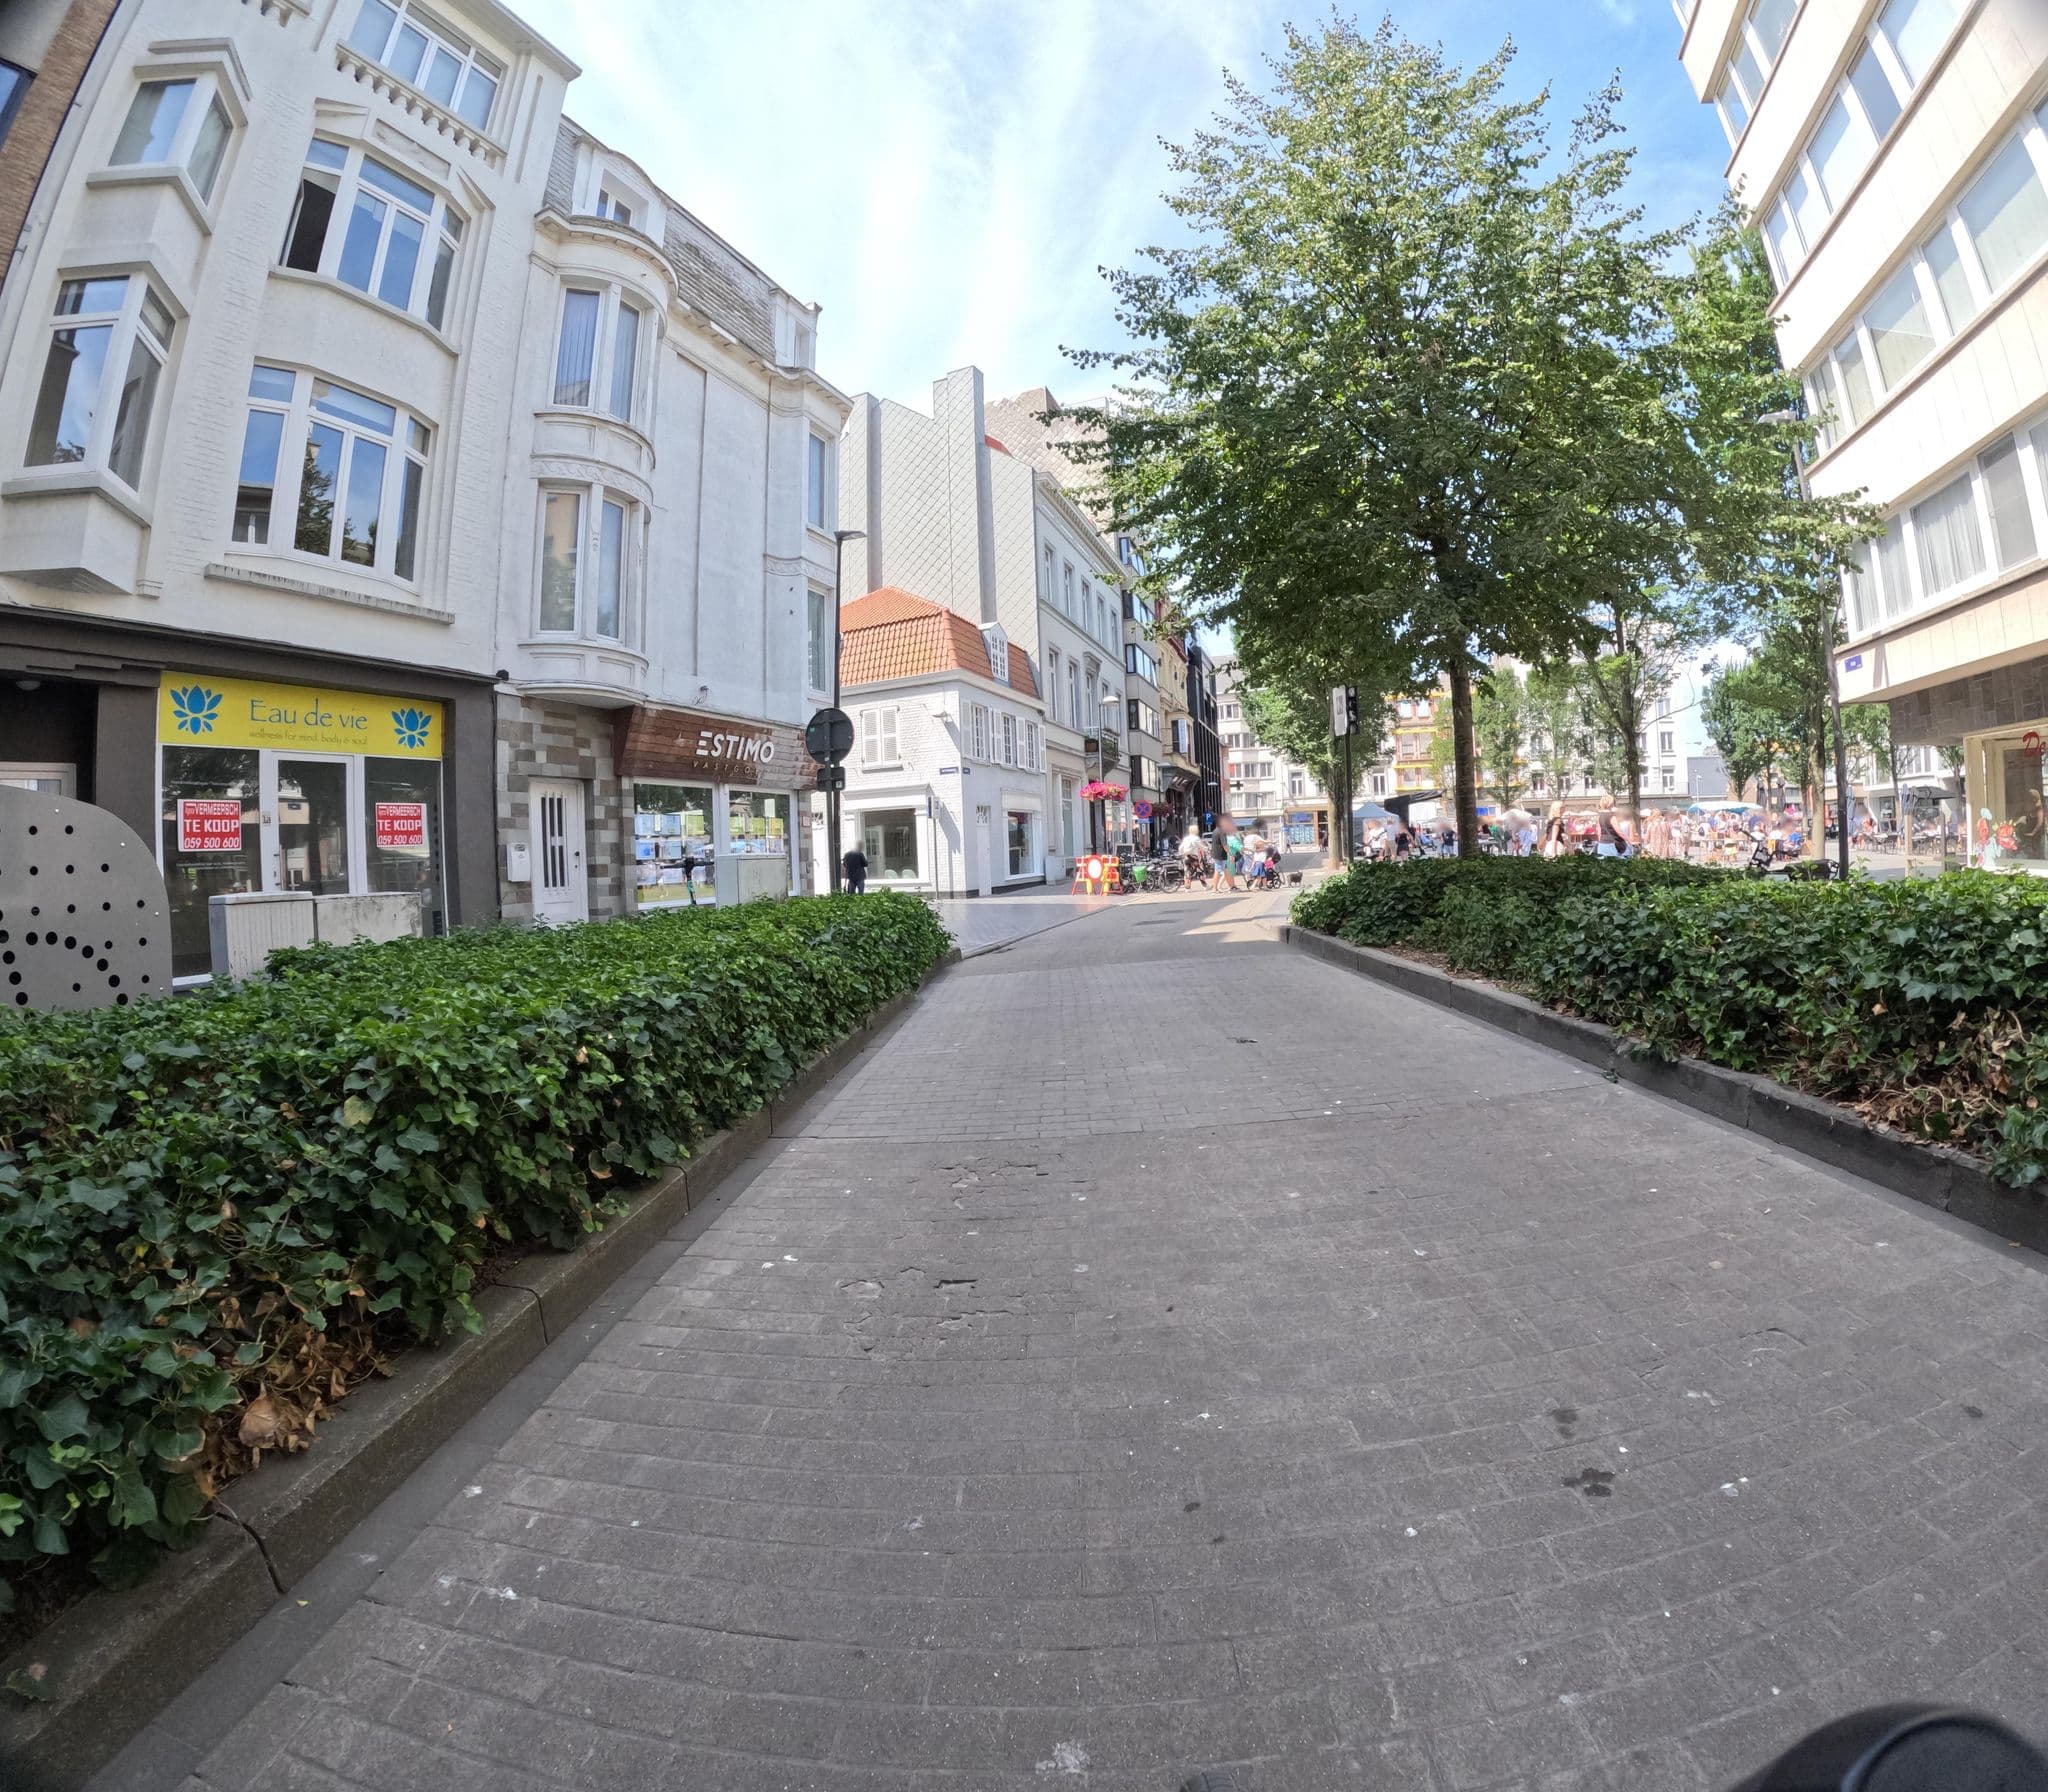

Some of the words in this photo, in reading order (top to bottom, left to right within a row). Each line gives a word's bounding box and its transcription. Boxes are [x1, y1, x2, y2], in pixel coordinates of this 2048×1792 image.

[249, 698, 297, 725] Eau
[303, 698, 333, 727] de
[339, 707, 368, 729] vie
[696, 731, 774, 763] ESTIMO
[194, 803, 239, 816] VERMEERSCH
[184, 819, 200, 832] TE
[204, 819, 239, 832] KOOP
[378, 820, 391, 831] TE
[394, 820, 421, 831] KOOP
[184, 837, 202, 849] 059
[203, 837, 221, 849] 500
[222, 837, 239, 849] 600
[378, 835, 392, 844] 059
[394, 835, 407, 844] 500
[409, 835, 421, 844] 600
